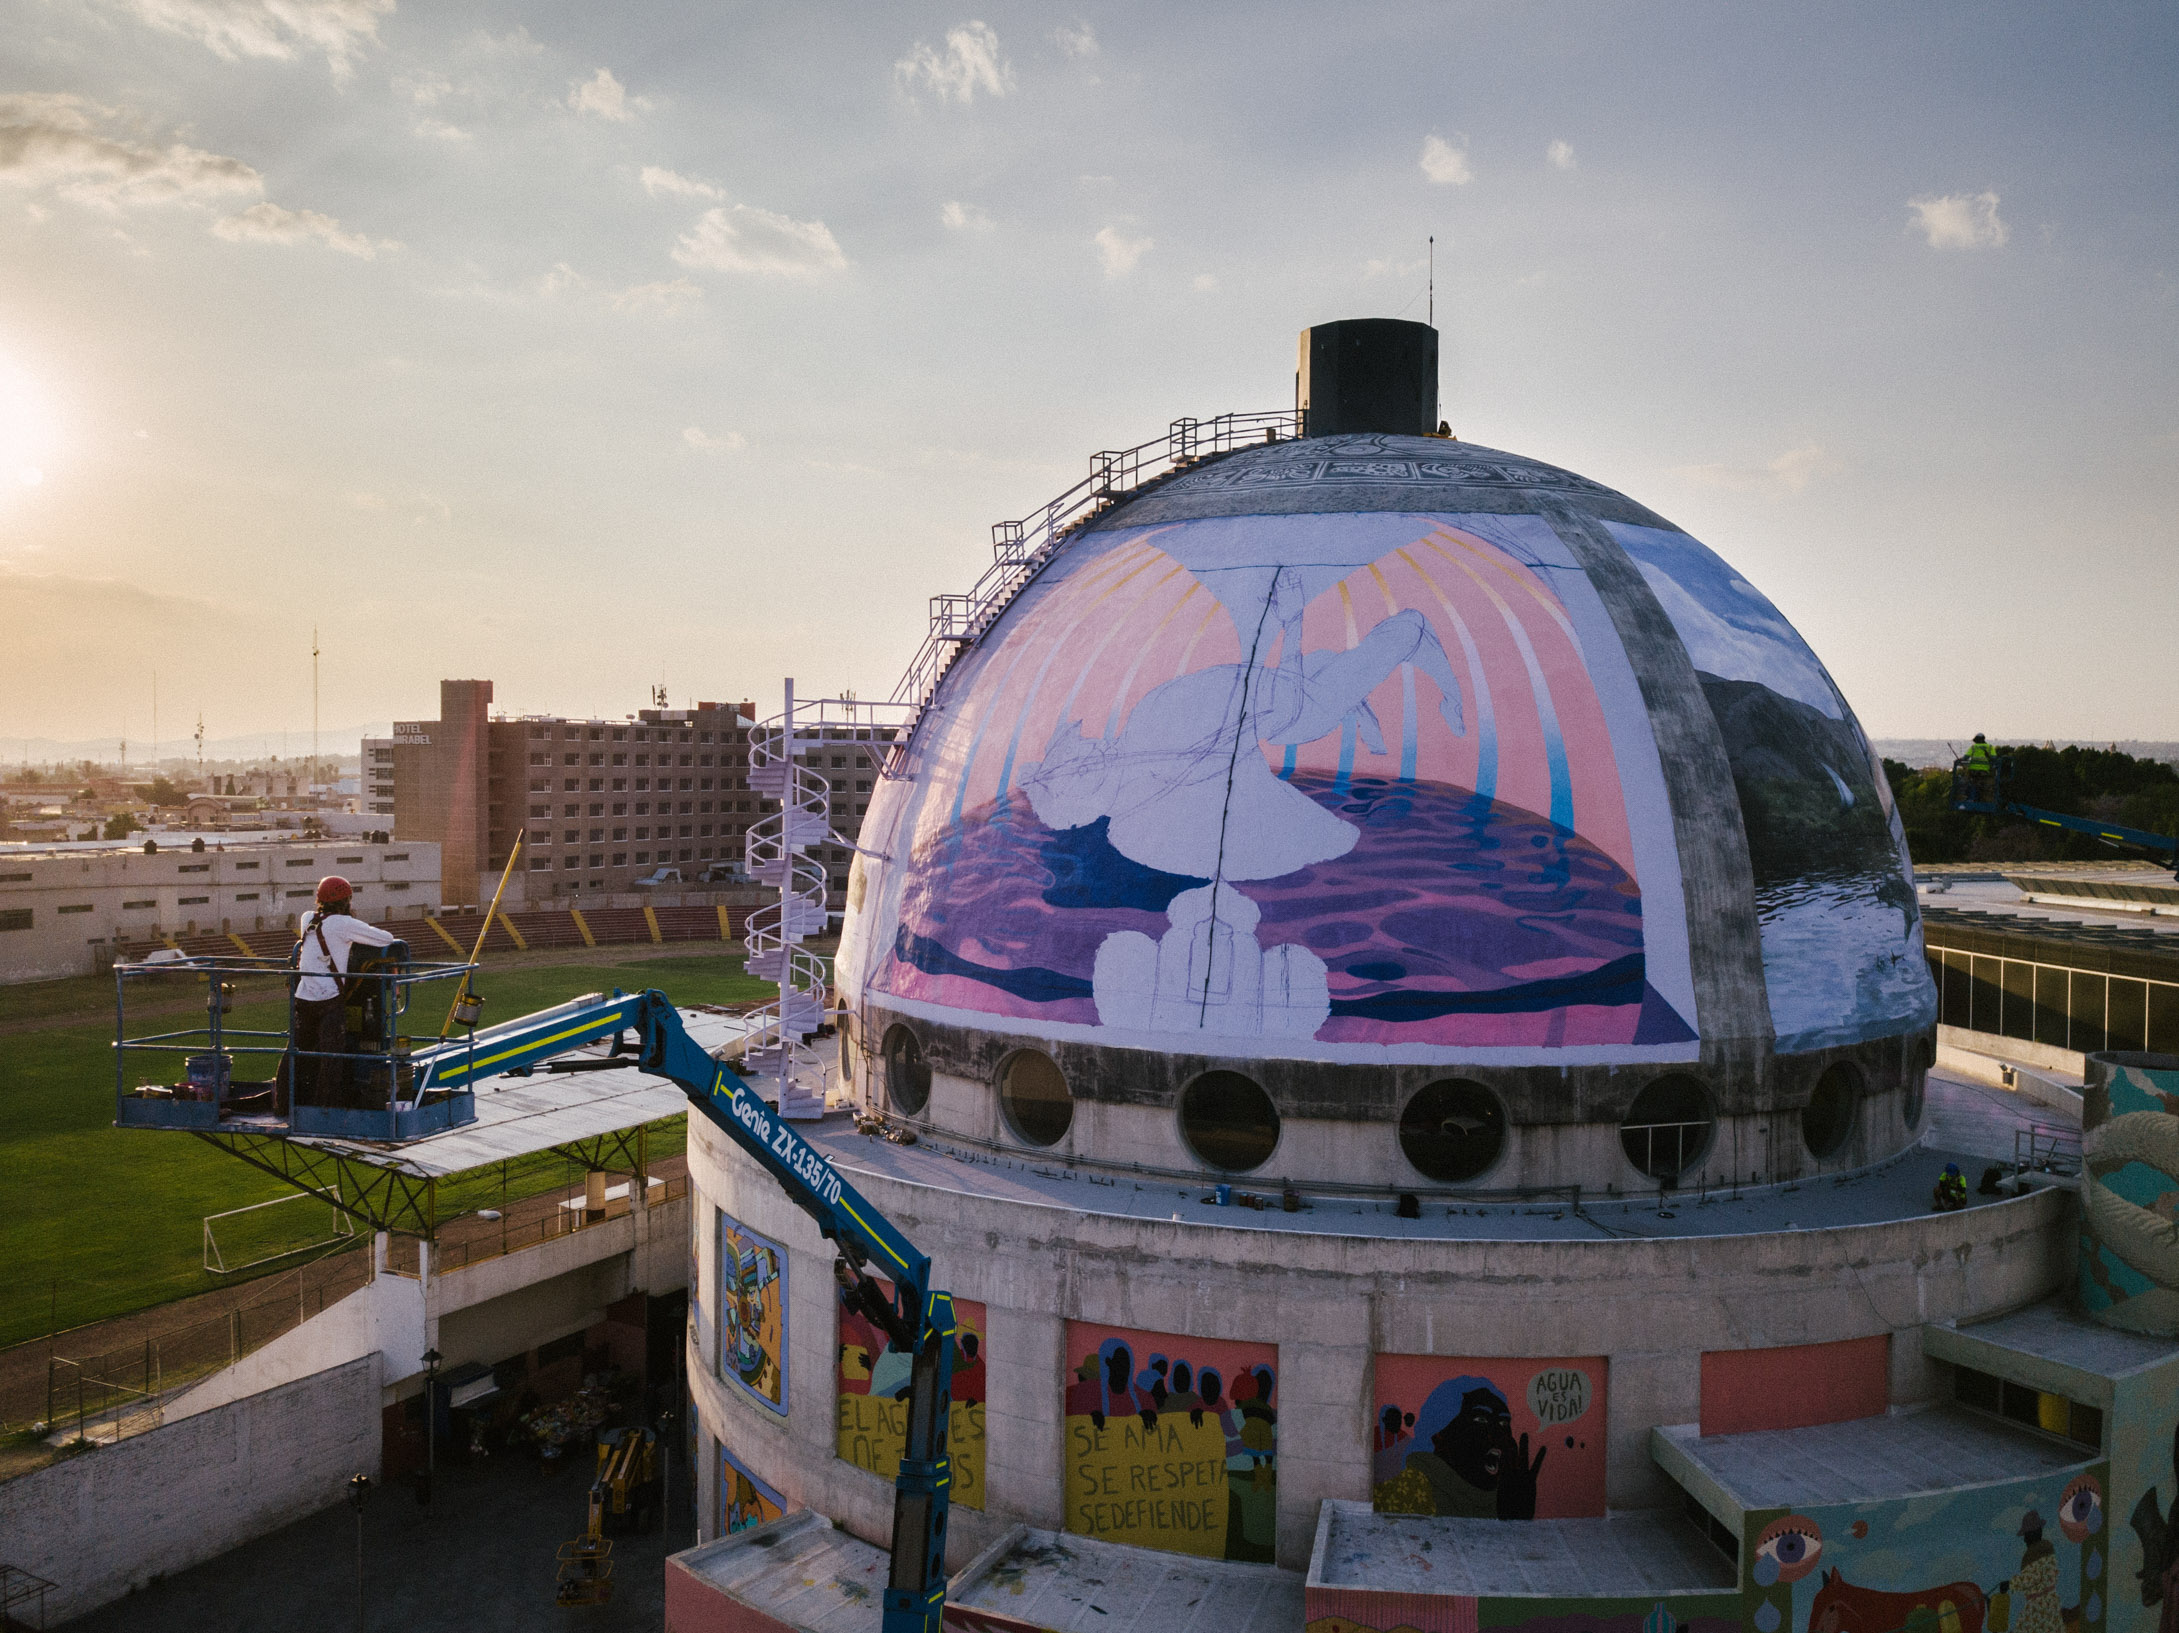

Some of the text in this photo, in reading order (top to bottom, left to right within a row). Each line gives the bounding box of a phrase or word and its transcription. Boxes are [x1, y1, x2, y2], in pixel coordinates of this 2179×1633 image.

[393, 723, 423, 734] HOTEL
[731, 1087, 842, 1205] Genie ZX-135/70
[1536, 1372, 1582, 1395] AGUA
[1552, 1391, 1567, 1402] ES
[838, 1398, 871, 1432] EL
[1538, 1394, 1583, 1421] VIDA!
[1073, 1423, 1184, 1458] SE AMA
[1077, 1458, 1229, 1496] SE RESPETA
